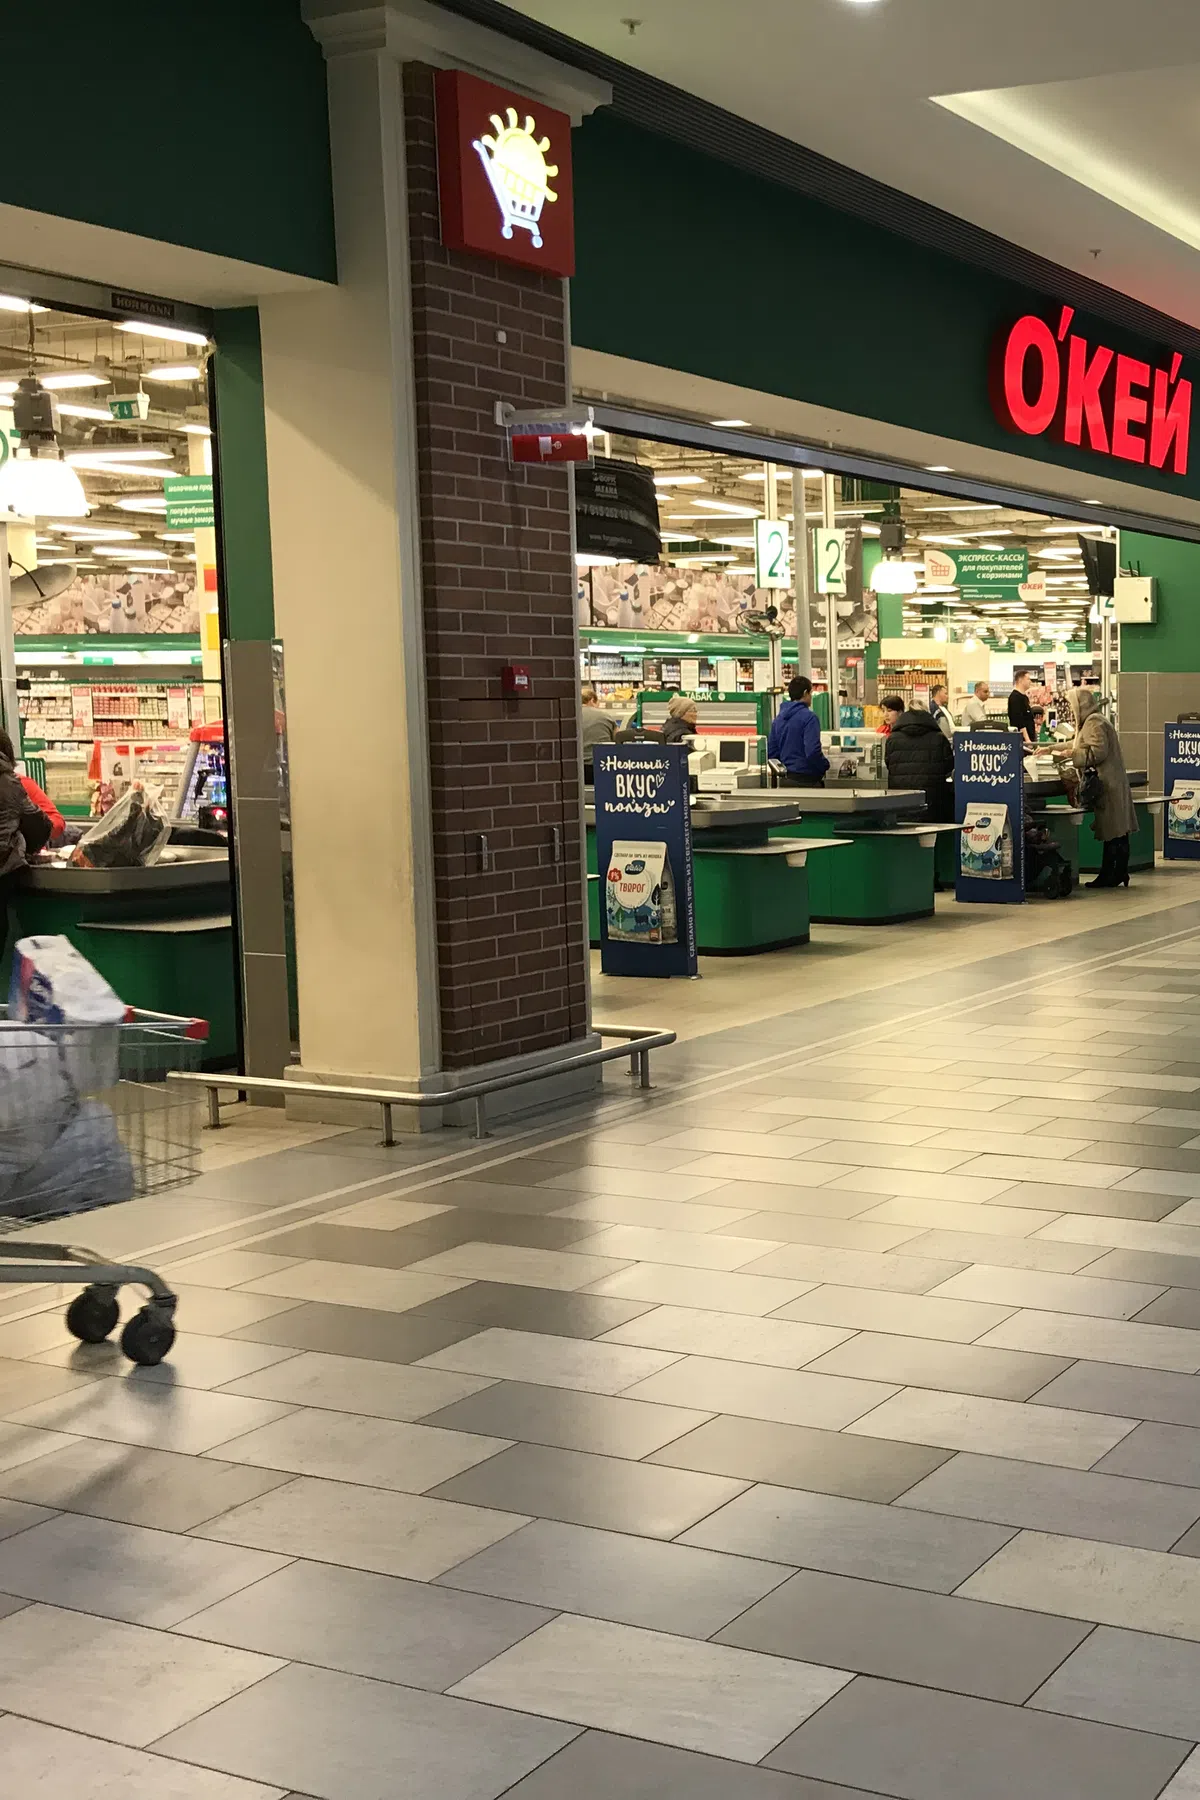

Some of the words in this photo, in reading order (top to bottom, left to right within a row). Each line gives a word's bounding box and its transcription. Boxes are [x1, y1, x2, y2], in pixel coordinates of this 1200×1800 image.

[958, 554, 1025, 562] ЭКСПРЕСС-КАССЫ
[961, 564, 976, 573] для
[976, 563, 1024, 573] покупателей
[981, 572, 1023, 581] корзинами
[685, 691, 713, 701] ТАБАК
[963, 739, 1009, 752] Нежный
[606, 755, 665, 772] Нежный
[970, 753, 1002, 773] ВКУС
[615, 773, 657, 799] ВКУС
[961, 773, 1013, 787] пользы
[604, 800, 671, 818] пользы
[971, 833, 991, 842] ТВОРОГ
[620, 882, 645, 893] ТВОРОГ
